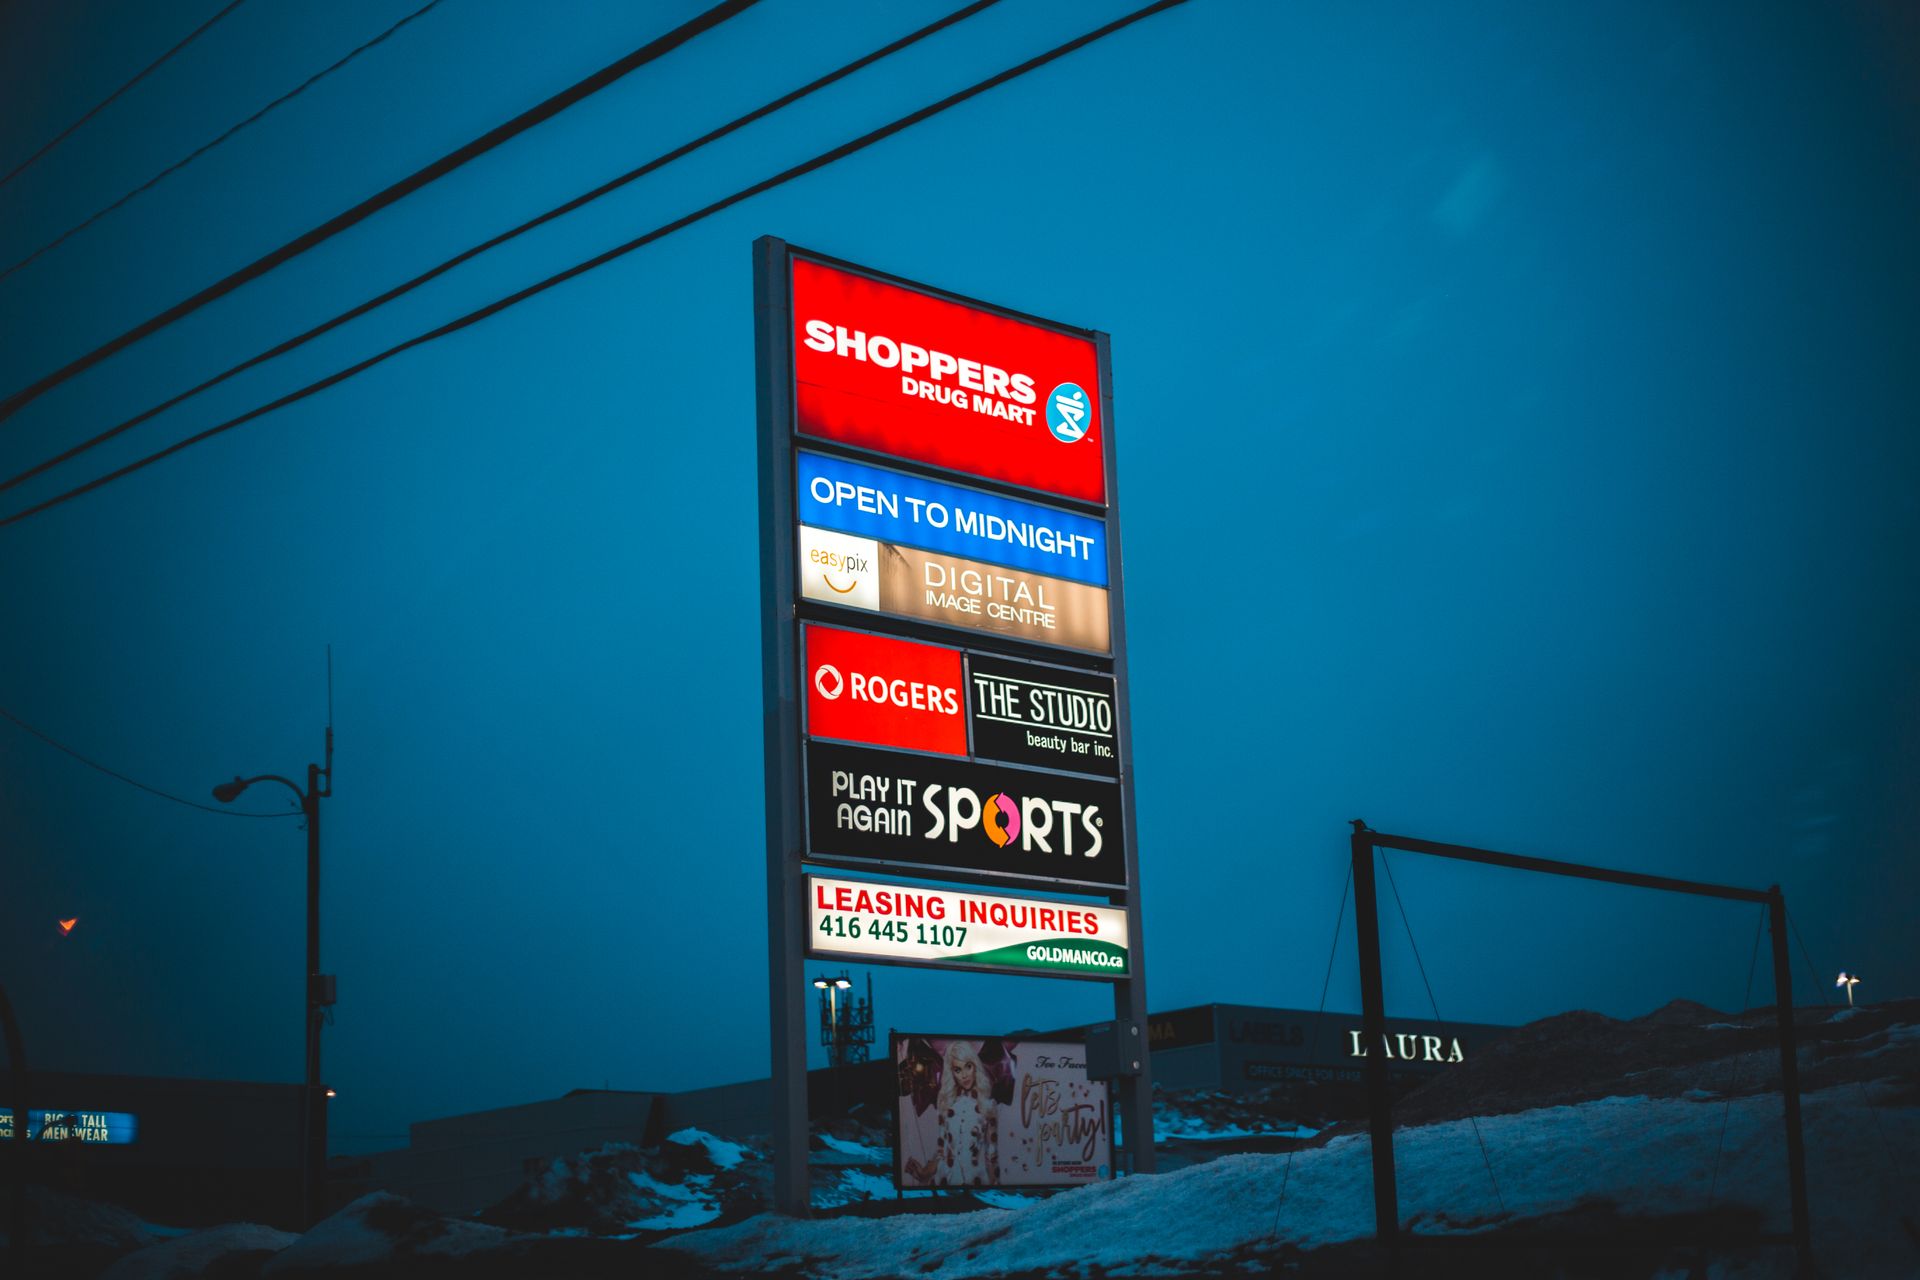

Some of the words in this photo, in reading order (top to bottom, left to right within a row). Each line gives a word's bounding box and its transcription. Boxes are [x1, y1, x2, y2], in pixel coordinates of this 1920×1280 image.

[804, 319, 1036, 404] SHOPPERS
[902, 376, 968, 409] DRUG
[973, 395, 1036, 426] MART
[810, 477, 898, 518] OPEN
[905, 496, 948, 528] TO
[955, 508, 1095, 560] MIDNIGHT
[810, 546, 868, 574] easypix
[924, 561, 1055, 611] DIGITAL
[926, 590, 981, 615] IMAGE
[987, 602, 1055, 629] CENTRE
[850, 672, 959, 715] ROGERS
[974, 679, 1022, 718] THE
[1030, 688, 1112, 732] STUDIO
[1026, 730, 1066, 754] beauty
[1070, 739, 1090, 754] bar
[1094, 742, 1114, 758] inc.
[832, 770, 889, 803] PLAY
[897, 778, 917, 806] IT
[837, 803, 912, 836] AGAIN
[816, 885, 946, 921] LEASING
[960, 899, 1100, 936] INQUIRIES
[819, 915, 861, 939] 416
[868, 919, 908, 943] 445
[916, 923, 967, 948] 1107
[1027, 945, 1123, 968] GOLDMANCO.ca
[1035, 1056, 1056, 1069] Too
[1058, 1056, 1088, 1069] Face
[75, 1128, 108, 1141] WEAR
[82, 1115, 106, 1128] TALL
